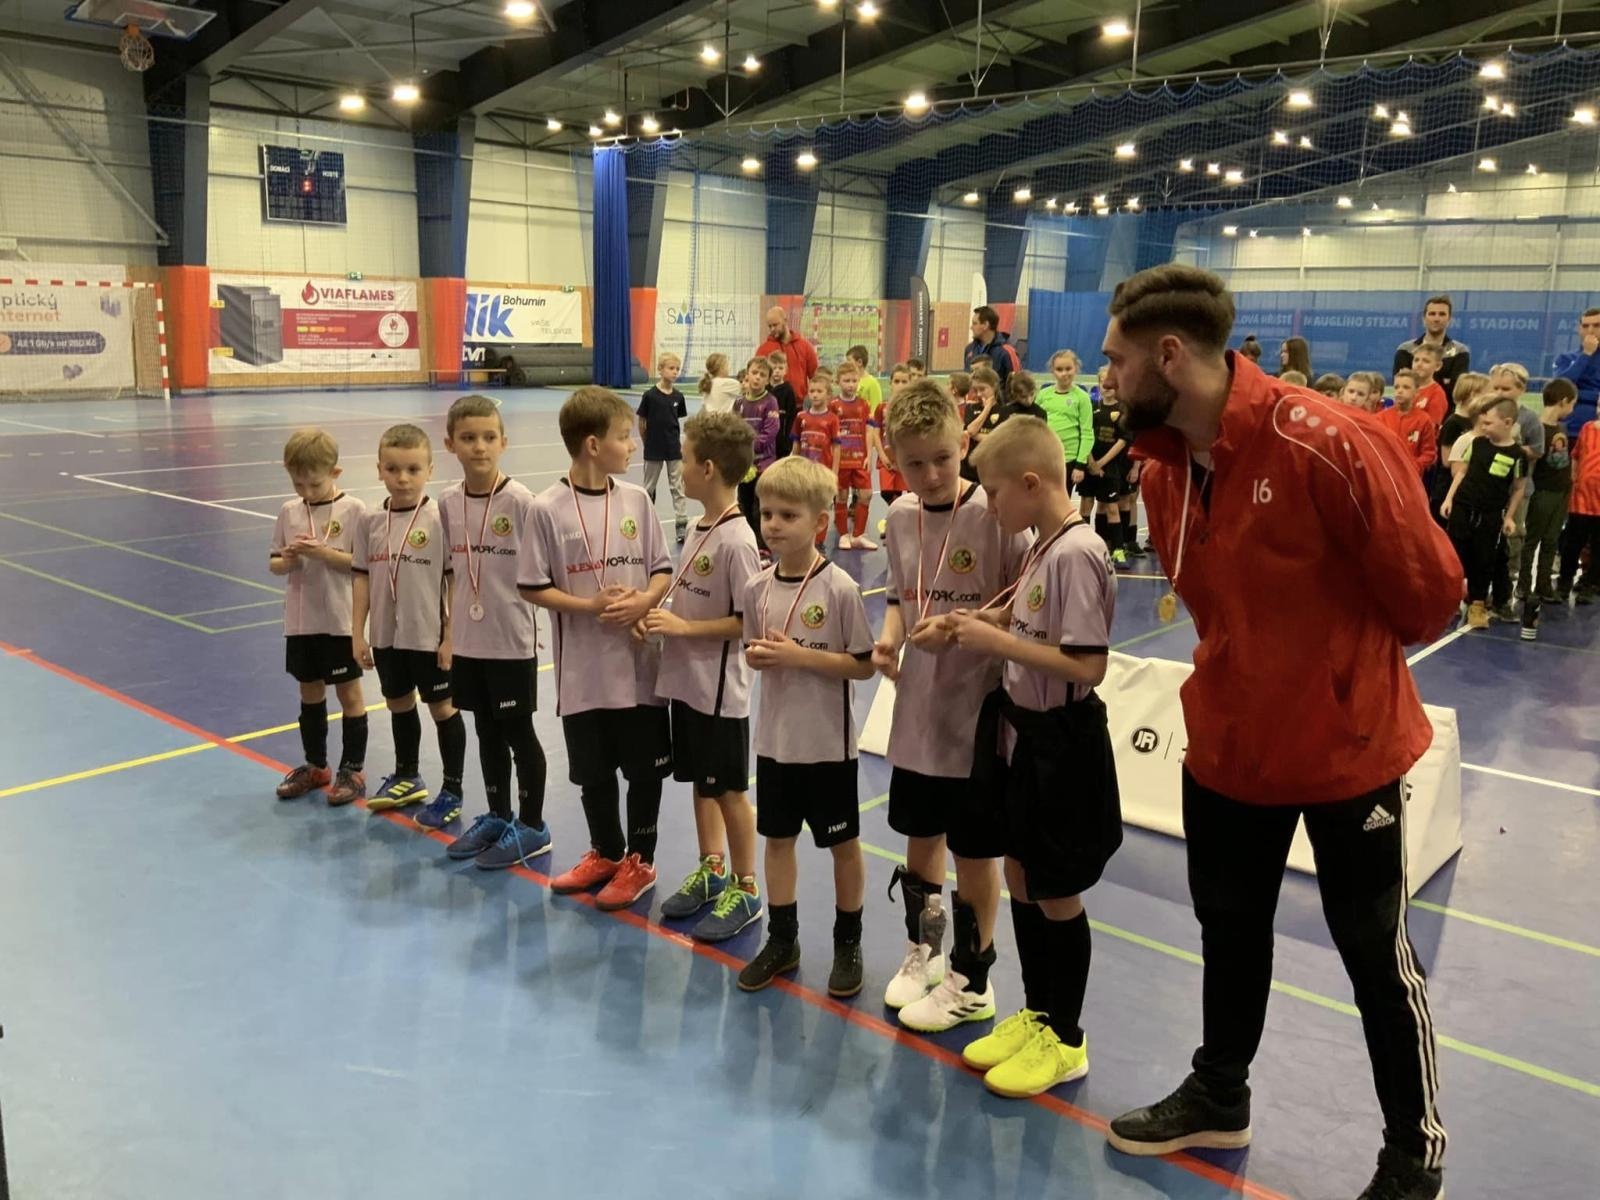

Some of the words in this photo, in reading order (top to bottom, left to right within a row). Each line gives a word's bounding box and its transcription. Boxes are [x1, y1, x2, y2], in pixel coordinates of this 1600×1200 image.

[320, 287, 395, 301] VIAFLAMES
[2, 292, 58, 310] ptický
[0, 309, 60, 322] nternet
[1366, 316, 1408, 329] STEZKA
[1470, 318, 1539, 330] STADION
[1253, 478, 1273, 504] 16
